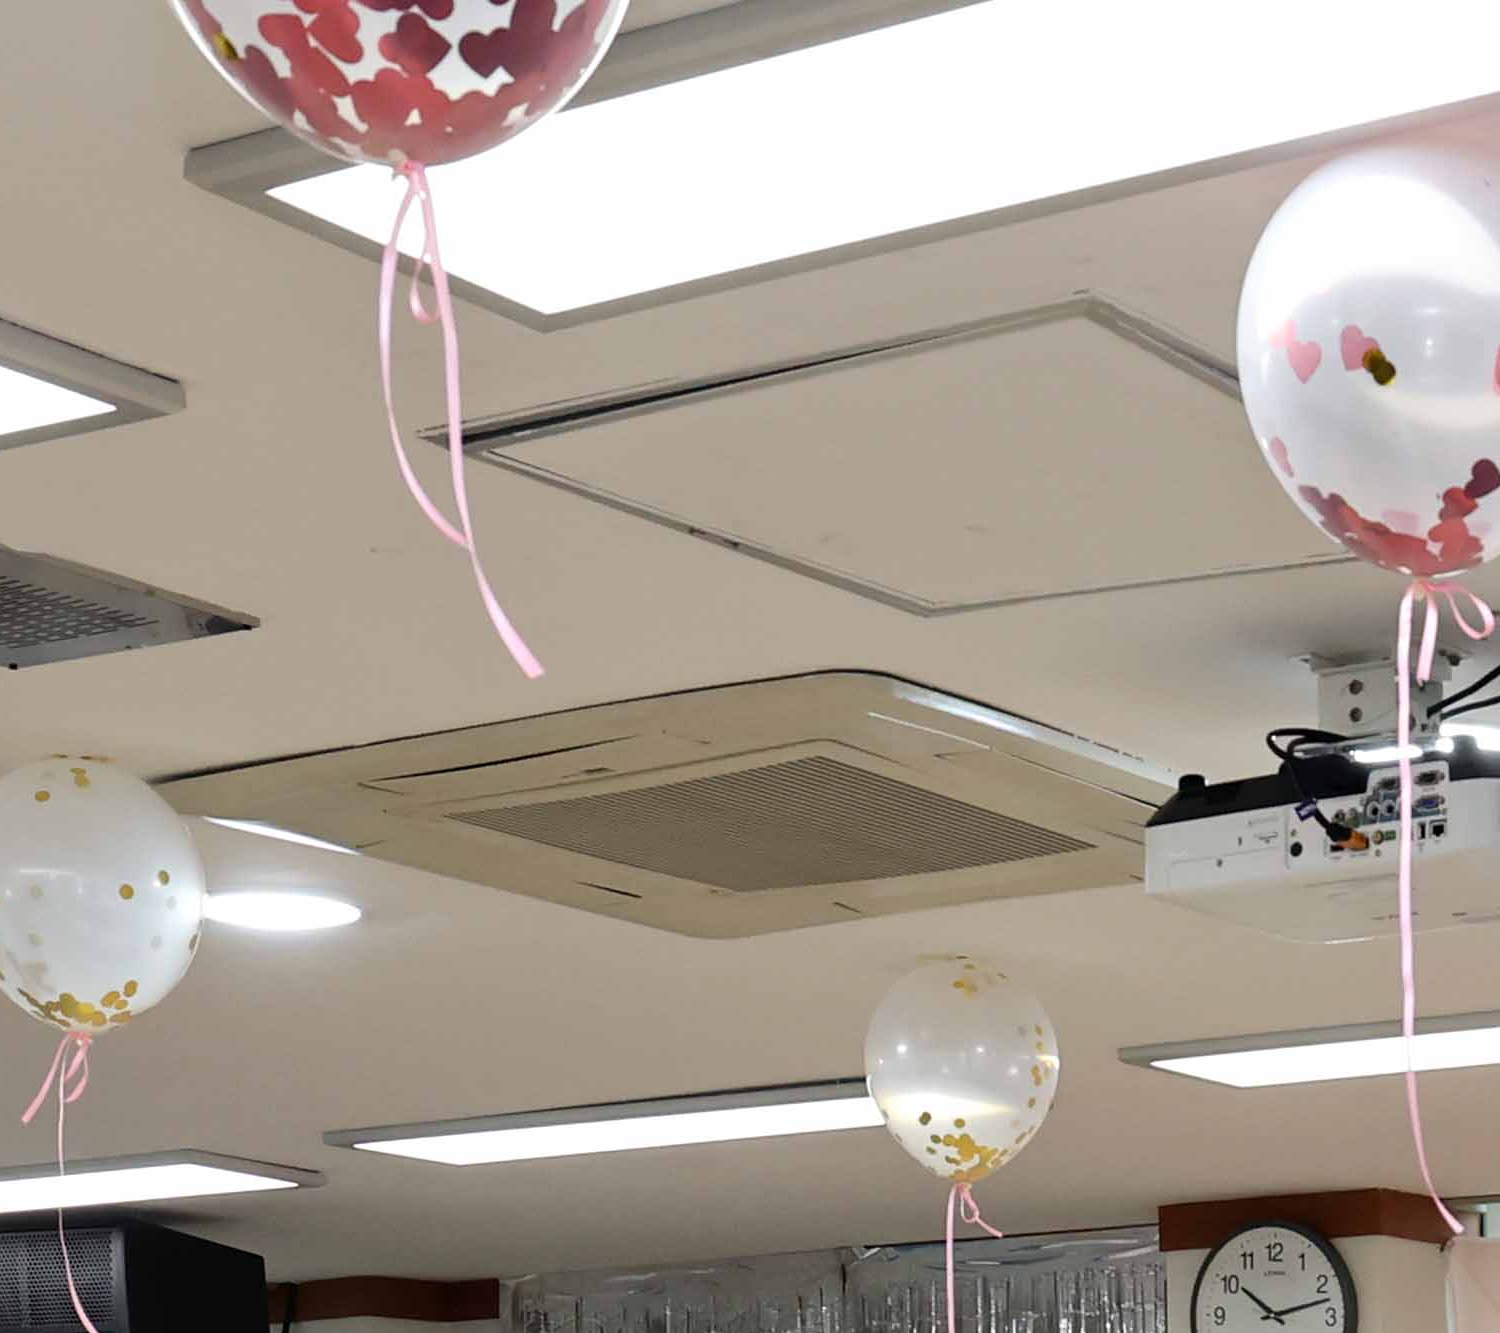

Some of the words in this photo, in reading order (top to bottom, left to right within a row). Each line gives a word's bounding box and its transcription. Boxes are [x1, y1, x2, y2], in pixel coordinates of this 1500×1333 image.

[1241, 1252, 1254, 1270] 11
[1266, 1243, 1284, 1262] 12
[1298, 1253, 1305, 1270] 1
[1221, 1275, 1239, 1294] 10
[1316, 1275, 1328, 1293] 2
[1214, 1307, 1225, 1325] 9
[1325, 1308, 1337, 1327] 3
